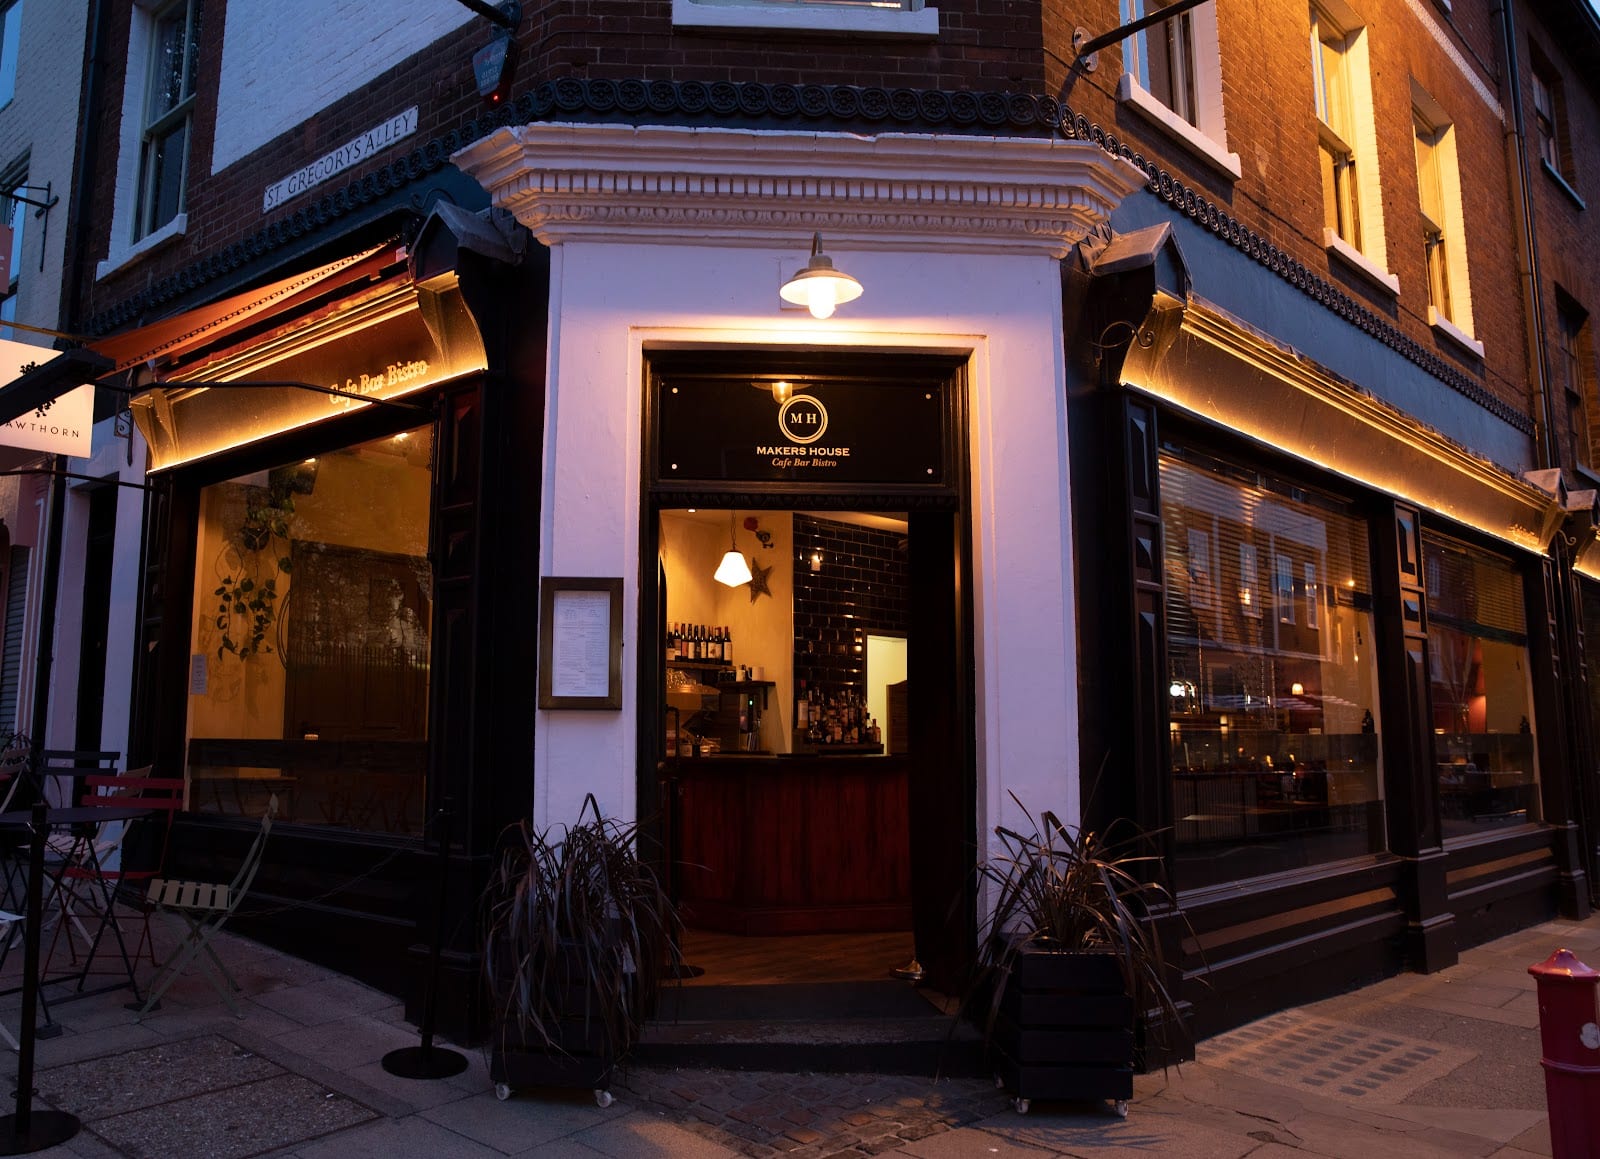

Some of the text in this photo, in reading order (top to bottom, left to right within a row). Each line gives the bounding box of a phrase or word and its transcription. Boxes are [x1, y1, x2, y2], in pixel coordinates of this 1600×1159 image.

[365, 111, 412, 154] ALLEY
[360, 373, 384, 395] Bar
[386, 360, 428, 387] Bistro
[756, 446, 850, 457] MAKERS HOUSE
[771, 457, 837, 468] Cafe Bar Bistro
